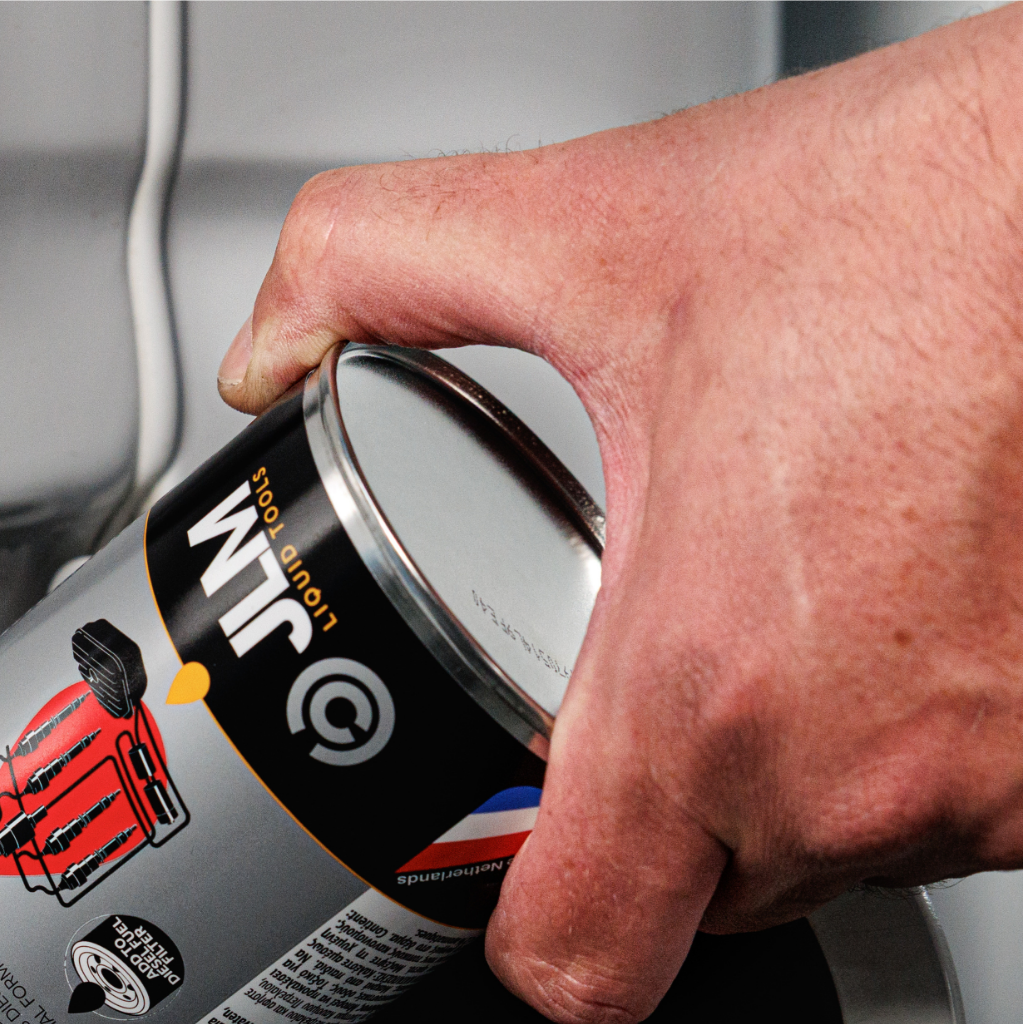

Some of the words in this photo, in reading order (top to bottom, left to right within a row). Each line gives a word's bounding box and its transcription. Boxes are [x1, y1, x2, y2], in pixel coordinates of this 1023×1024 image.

[250, 465, 286, 540] TOOLS
[186, 479, 312, 658] JLM
[278, 544, 338, 631] LIQUID
[396, 860, 503, 886] Netherlands
[111, 915, 142, 948] FUEL
[328, 918, 393, 954] κανονισμούς.
[339, 908, 390, 939] Contient:
[112, 937, 132, 958] TO
[132, 924, 174, 964] FILTER
[303, 937, 347, 964] αμέσως
[315, 926, 359, 953] χυμένη
[384, 930, 418, 950] δέρμα.
[128, 952, 160, 979] ADD
[141, 945, 181, 985] DIESEL
[279, 958, 303, 973] για
[290, 948, 313, 964] Να
[354, 947, 373, 960] τη
[294, 968, 332, 990] Τοξικό
[308, 959, 346, 981] παιδιά.
[338, 957, 377, 978] Καλέστε
[341, 975, 365, 987] από
[253, 976, 304, 1009] Πετρελαίου,
[265, 967, 323, 1000] προκαλέσει
[240, 986, 279, 1009] αφήστε
[270, 1003, 289, 1016] και
